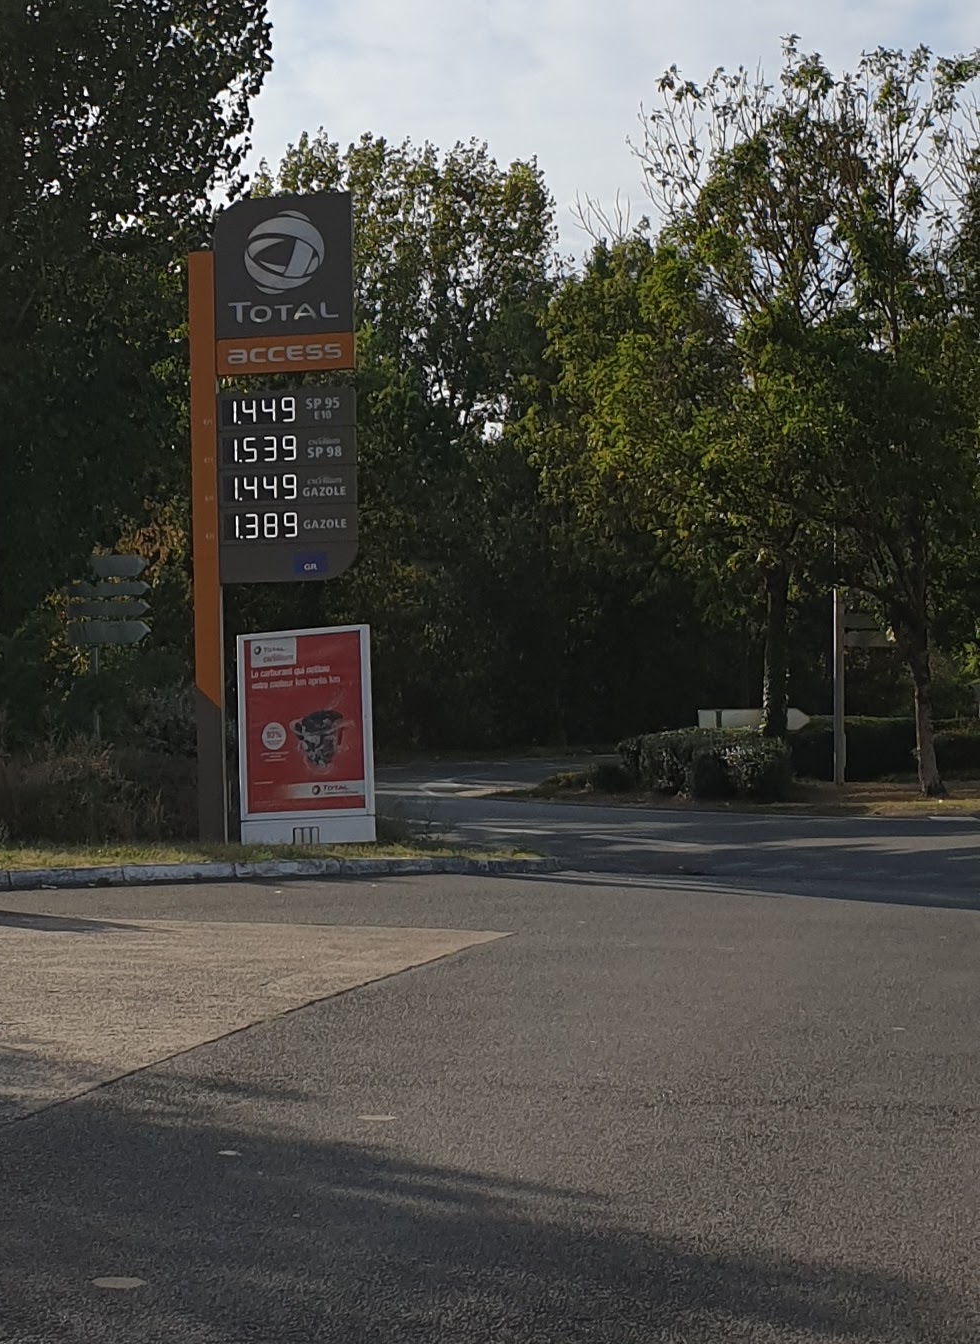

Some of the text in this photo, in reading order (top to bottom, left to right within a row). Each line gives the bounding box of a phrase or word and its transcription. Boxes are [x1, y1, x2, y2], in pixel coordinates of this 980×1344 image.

[227, 301, 339, 323] TOTAL
[232, 396, 340, 425] 1.449 SP 95
[233, 435, 342, 463] 1.539 SP 98
[234, 473, 347, 502] 1.449 GAZOLE
[234, 512, 347, 540] 1.389 GAZOLE
